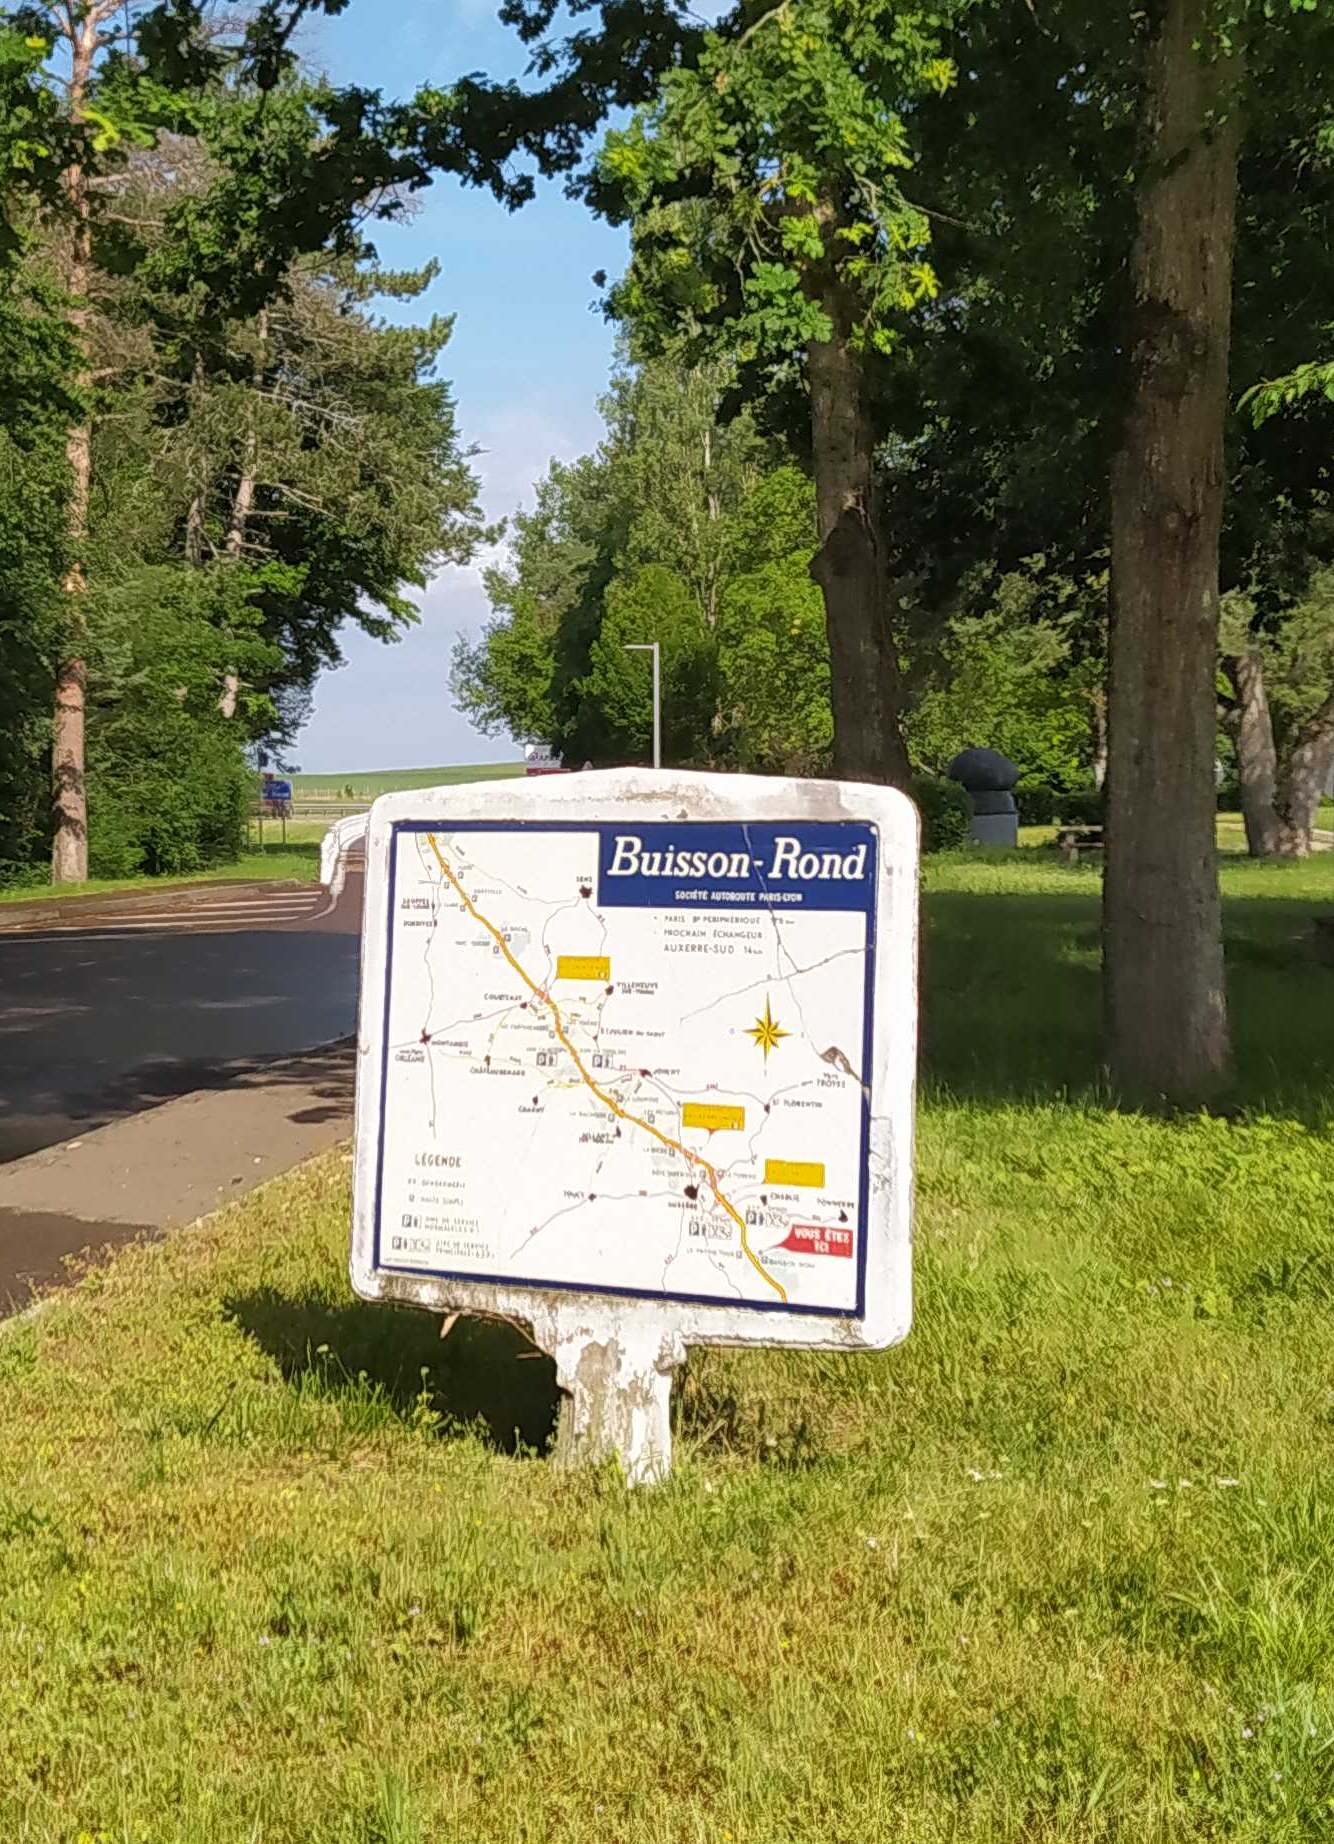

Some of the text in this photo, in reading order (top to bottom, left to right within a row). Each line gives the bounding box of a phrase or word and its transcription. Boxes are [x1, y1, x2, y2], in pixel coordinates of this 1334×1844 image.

[674, 889, 709, 901] SOCIÉTÉ
[710, 890, 757, 902] AUTOROUTE
[663, 914, 686, 924] PARIS
[663, 928, 763, 940] PROCHAIN ÉCHANGEUR
[663, 943, 735, 955] AUXERRE-SUD
[414, 1151, 462, 1168] LÉGENDE
[794, 1226, 850, 1243] VOUS ÊTES
